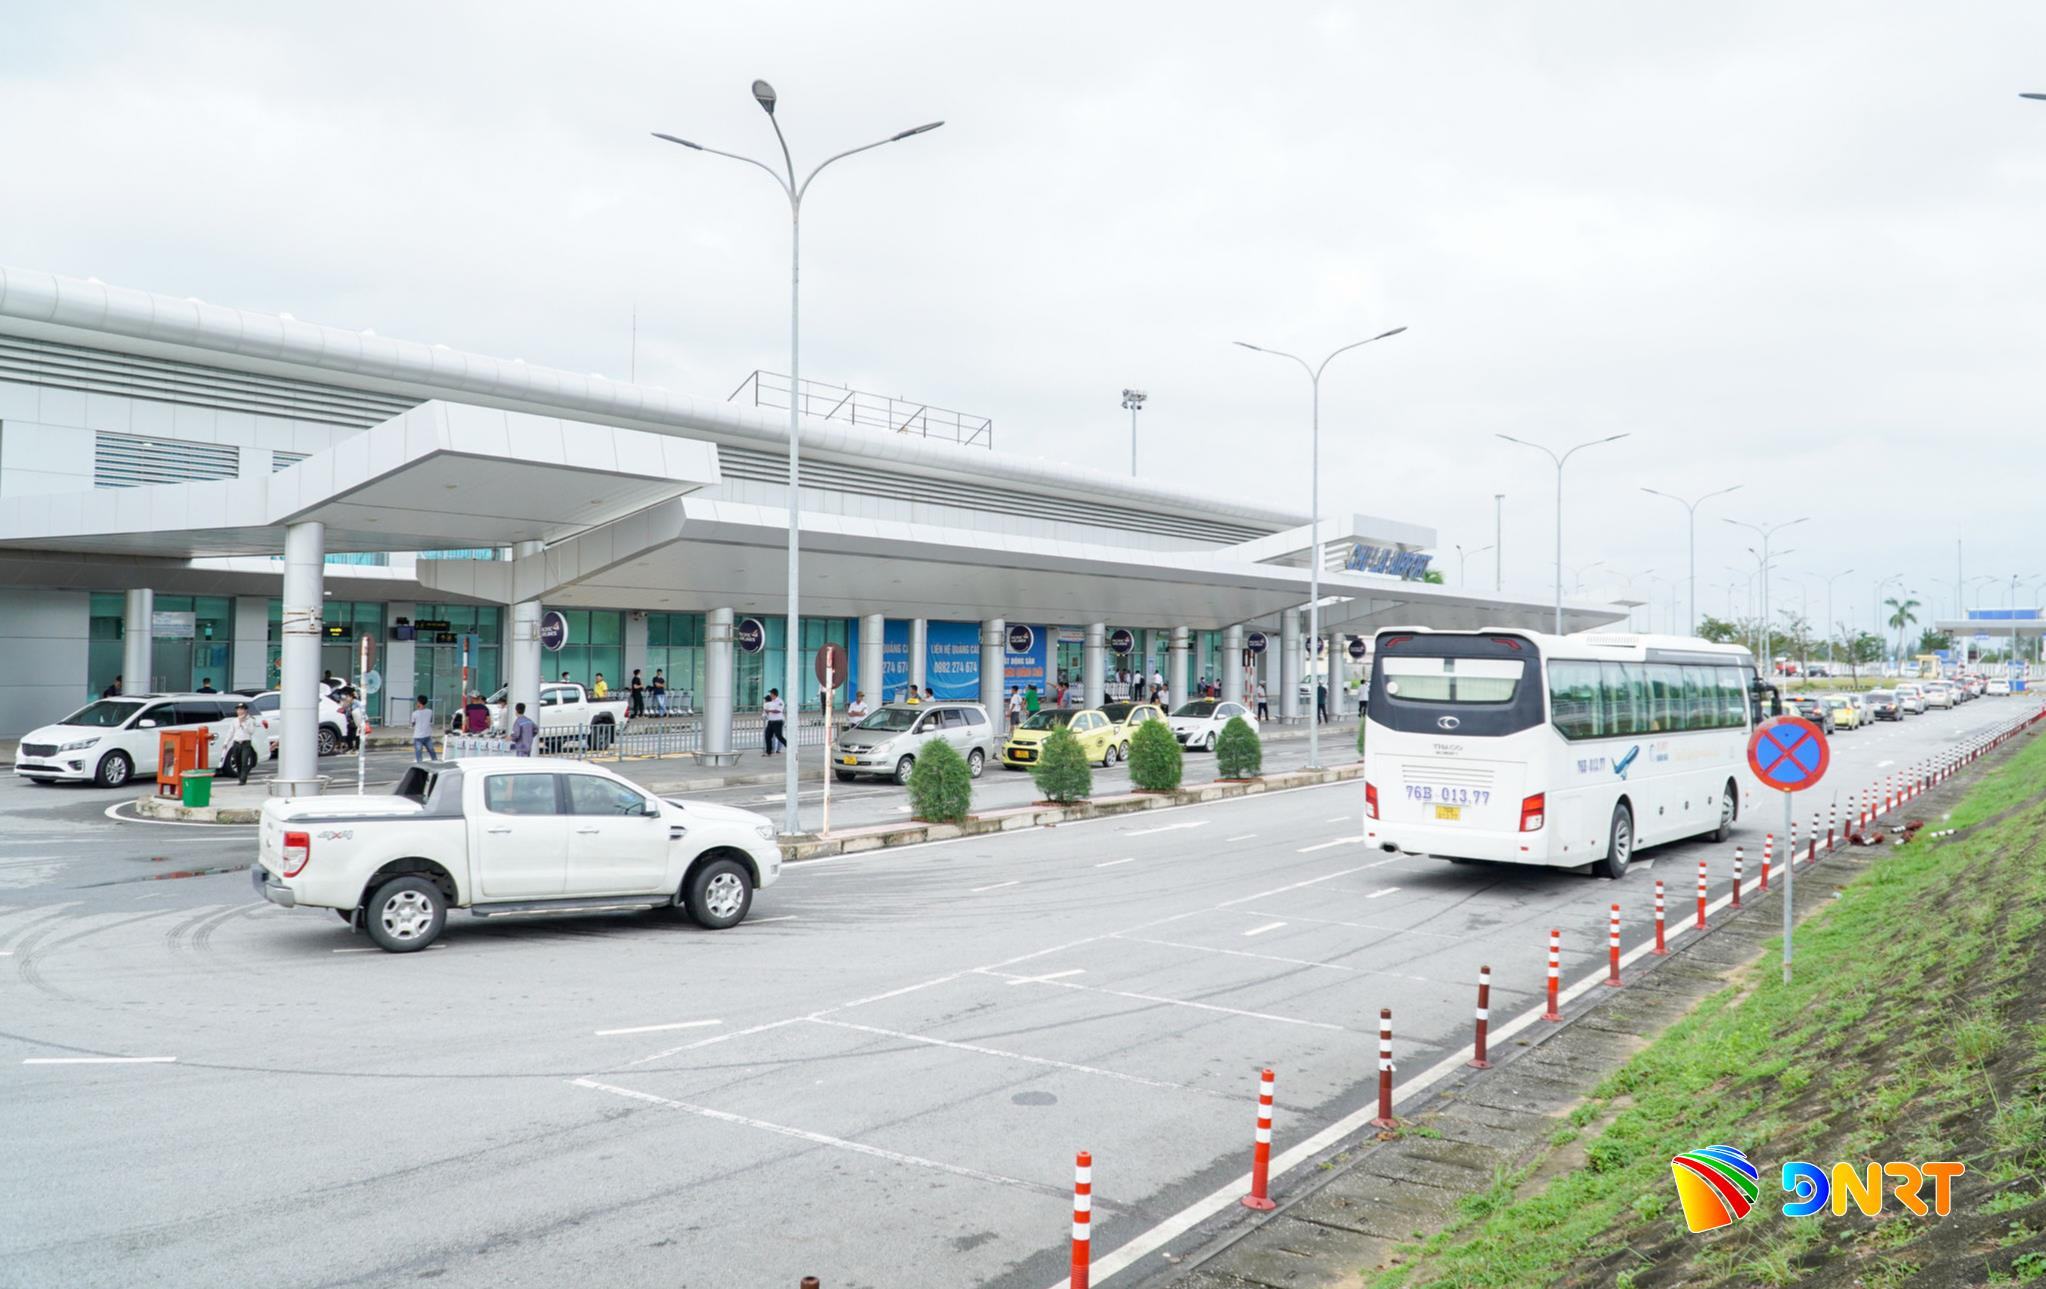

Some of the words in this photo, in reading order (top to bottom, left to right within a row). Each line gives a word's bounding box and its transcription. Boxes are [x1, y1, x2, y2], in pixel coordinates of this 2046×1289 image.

[951, 660, 964, 673] 274
[1405, 785, 1432, 800] 76B
[1441, 787, 1490, 806] 013.77
